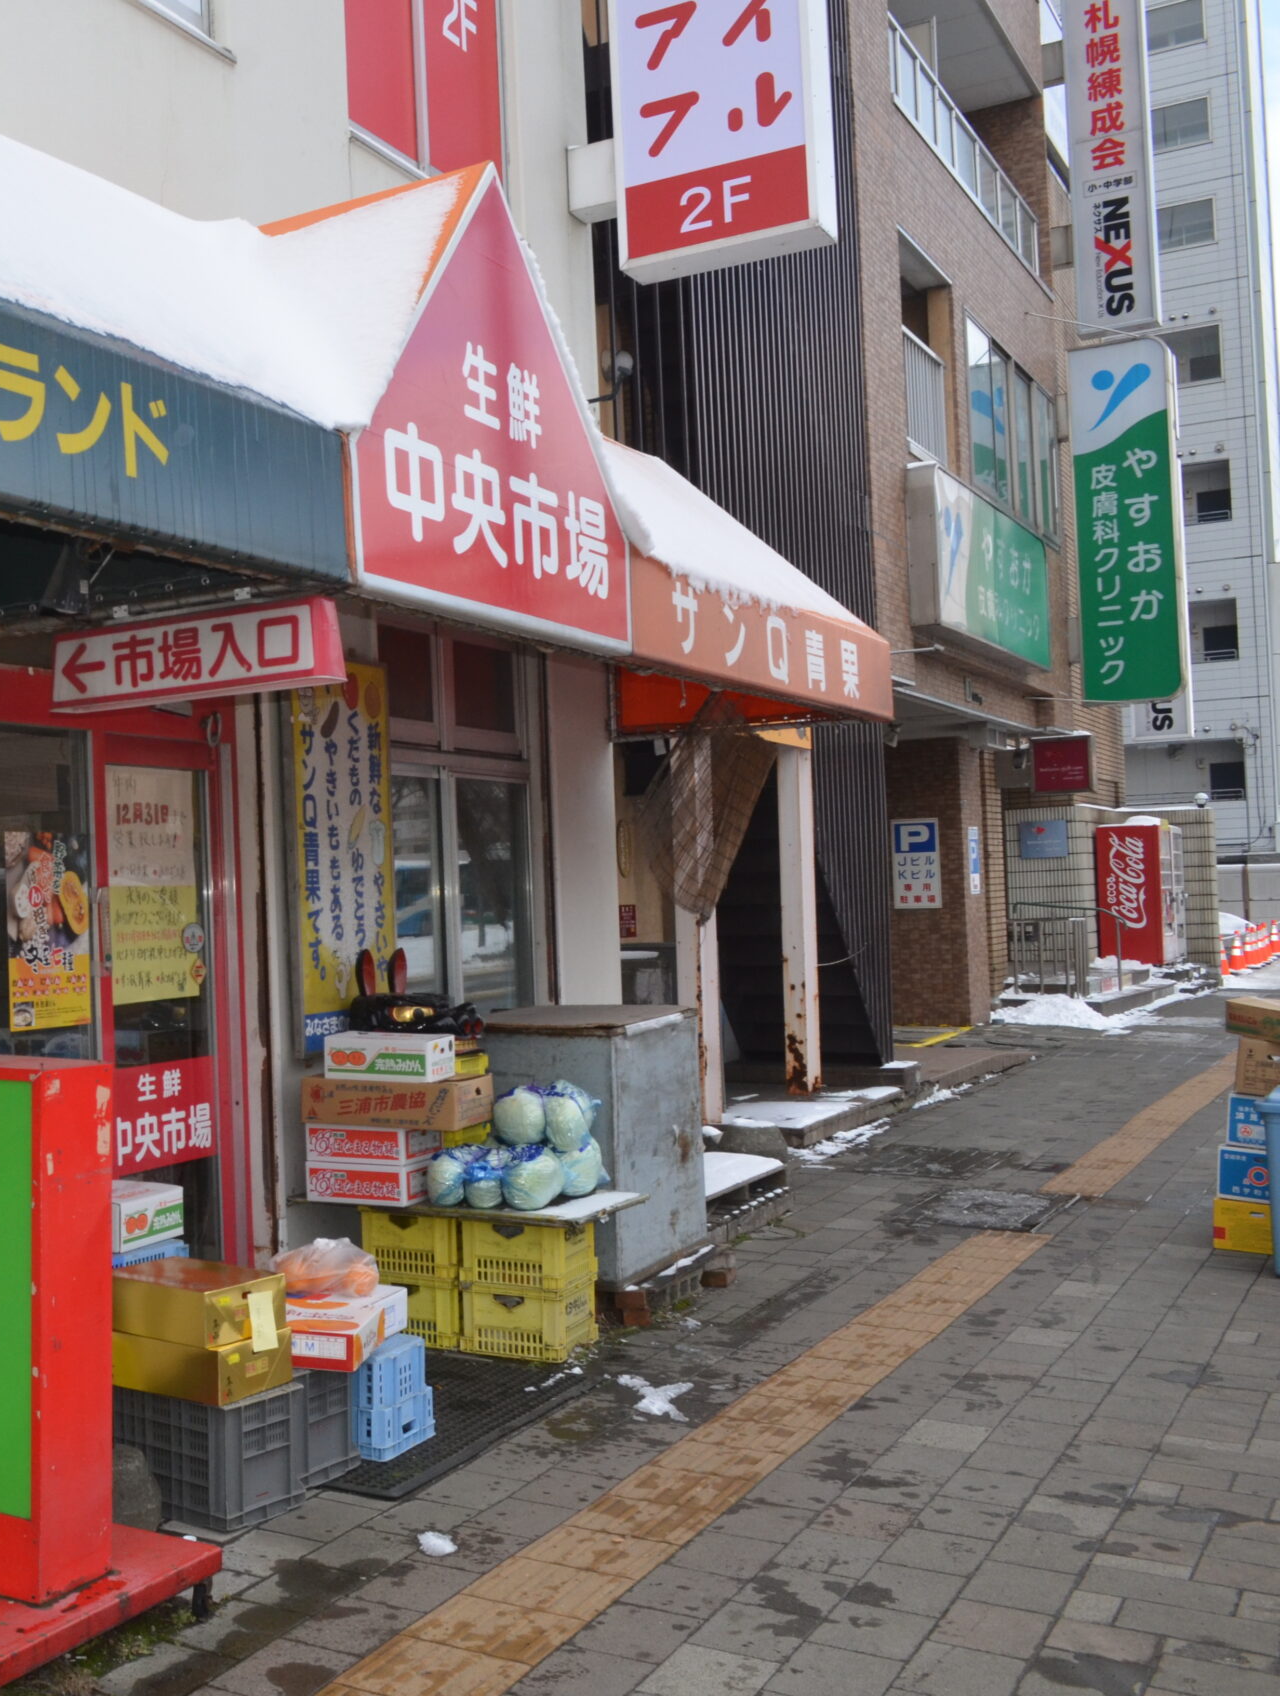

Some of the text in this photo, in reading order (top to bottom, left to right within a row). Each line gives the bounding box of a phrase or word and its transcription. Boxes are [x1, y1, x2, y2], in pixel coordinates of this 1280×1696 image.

[639, 71, 793, 158] フル
[1084, 0, 1125, 171] 札幌練成会
[679, 175, 752, 234] 2F
[1094, 196, 1135, 317] NEXUS
[462, 341, 543, 450] 生鮮
[383, 421, 610, 600] 中央市場
[1121, 447, 1164, 622] やすおか
[1090, 464, 1125, 685] 皮膚科クリニック
[112, 614, 300, 688] 市場入口
[347, 710, 367, 953] くだもの ゆでとう
[897, 855, 935, 867] Jビル
[897, 869, 936, 880] Kビル
[900, 824, 930, 852] P
[1108, 831, 1148, 929] Coca-Cola
[136, 1068, 182, 1102] 生鮮
[337, 1091, 427, 1116] 三浦市農協
[116, 1102, 213, 1167] 中央市場
